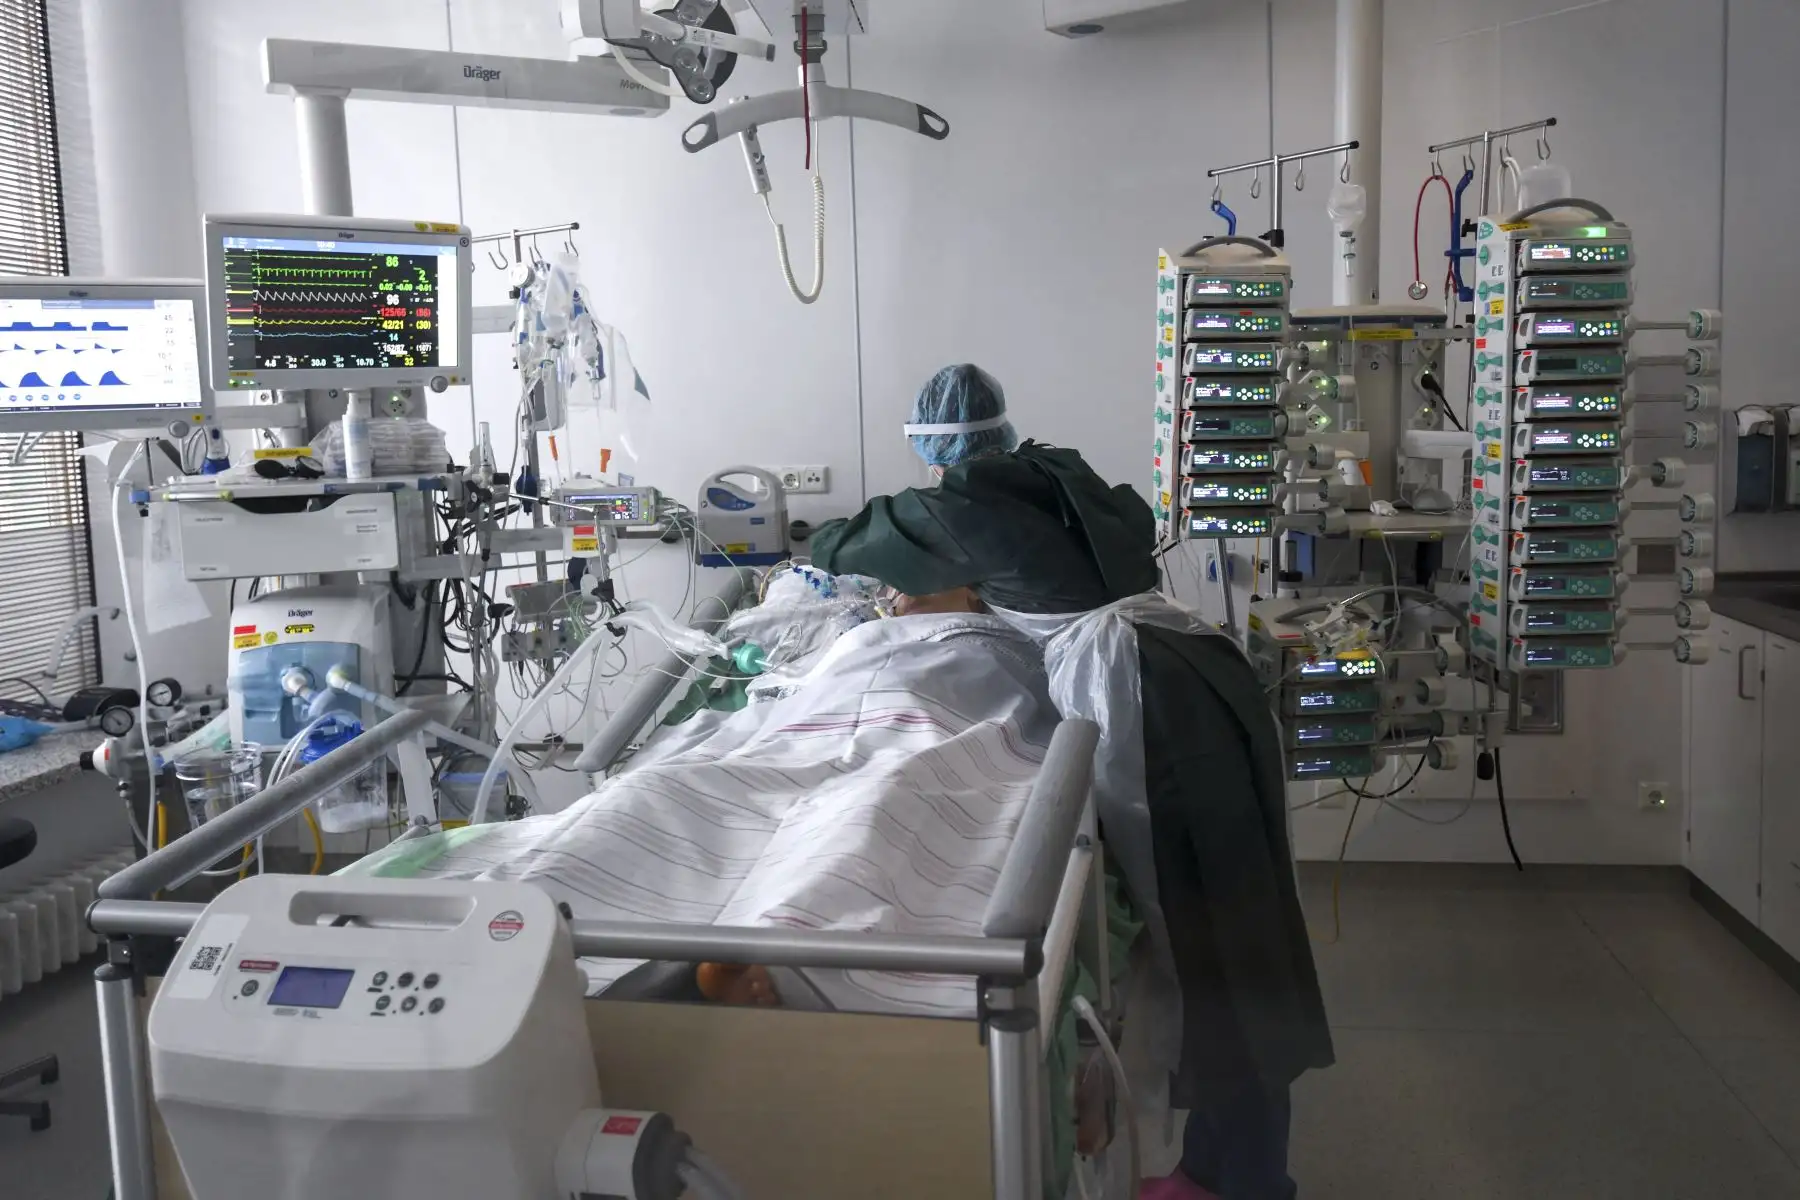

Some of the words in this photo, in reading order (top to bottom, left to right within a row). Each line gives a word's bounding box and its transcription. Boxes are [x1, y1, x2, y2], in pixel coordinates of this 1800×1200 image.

[463, 65, 501, 81] Dräger
[385, 255, 399, 267] 86
[418, 269, 426, 281] 2
[386, 294, 400, 305] 96
[382, 320, 404, 330] 42/21
[389, 333, 399, 342] 14
[404, 357, 414, 366] 32
[287, 608, 314, 618] Dräger
